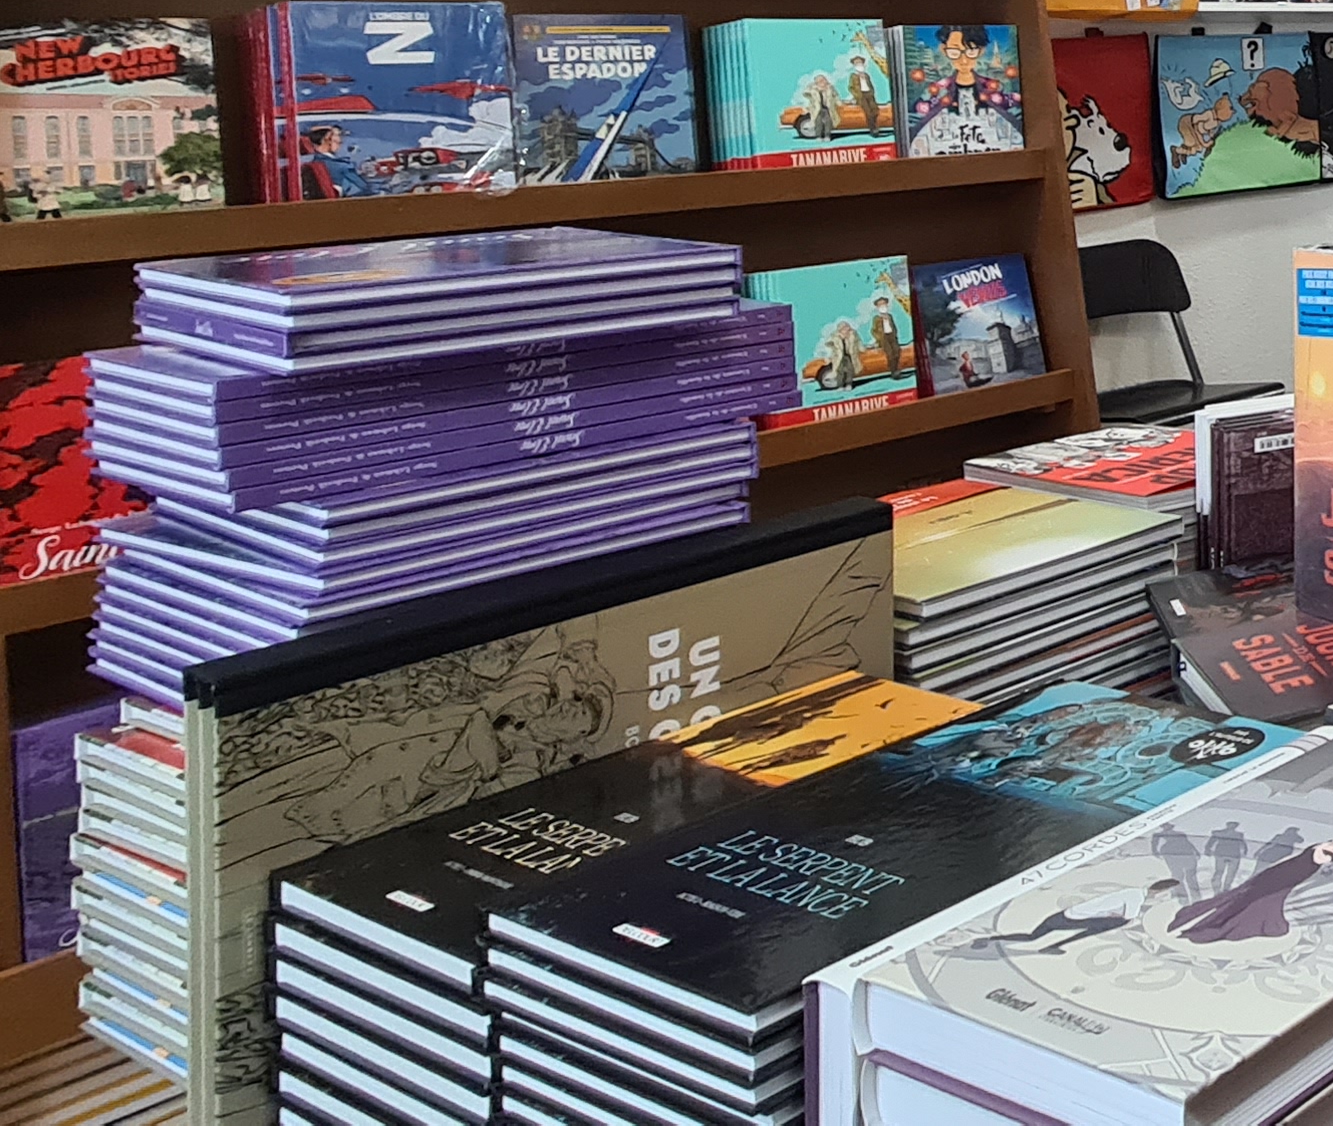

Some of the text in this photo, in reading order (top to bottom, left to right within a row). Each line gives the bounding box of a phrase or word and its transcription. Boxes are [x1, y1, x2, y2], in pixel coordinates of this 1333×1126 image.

[15, 36, 84, 61] NEW
[363, 21, 436, 65] Z
[536, 44, 658, 63] LE DERNIER
[548, 61, 652, 81] ESPADON
[790, 147, 869, 169] TANANARIVE
[942, 263, 1003, 295] LONDON
[812, 396, 890, 423] TANANARIVE
[647, 628, 682, 712] DES
[689, 635, 721, 700] UN
[1231, 632, 1316, 695] SABLE
[448, 820, 494, 841] ET
[499, 808, 537, 829] LE
[717, 830, 906, 896] LE SERPENT
[1019, 819, 1148, 887] 47 CORDES
[667, 846, 709, 868] ET
[698, 861, 750, 891] LA
[746, 868, 870, 920] LANCE
